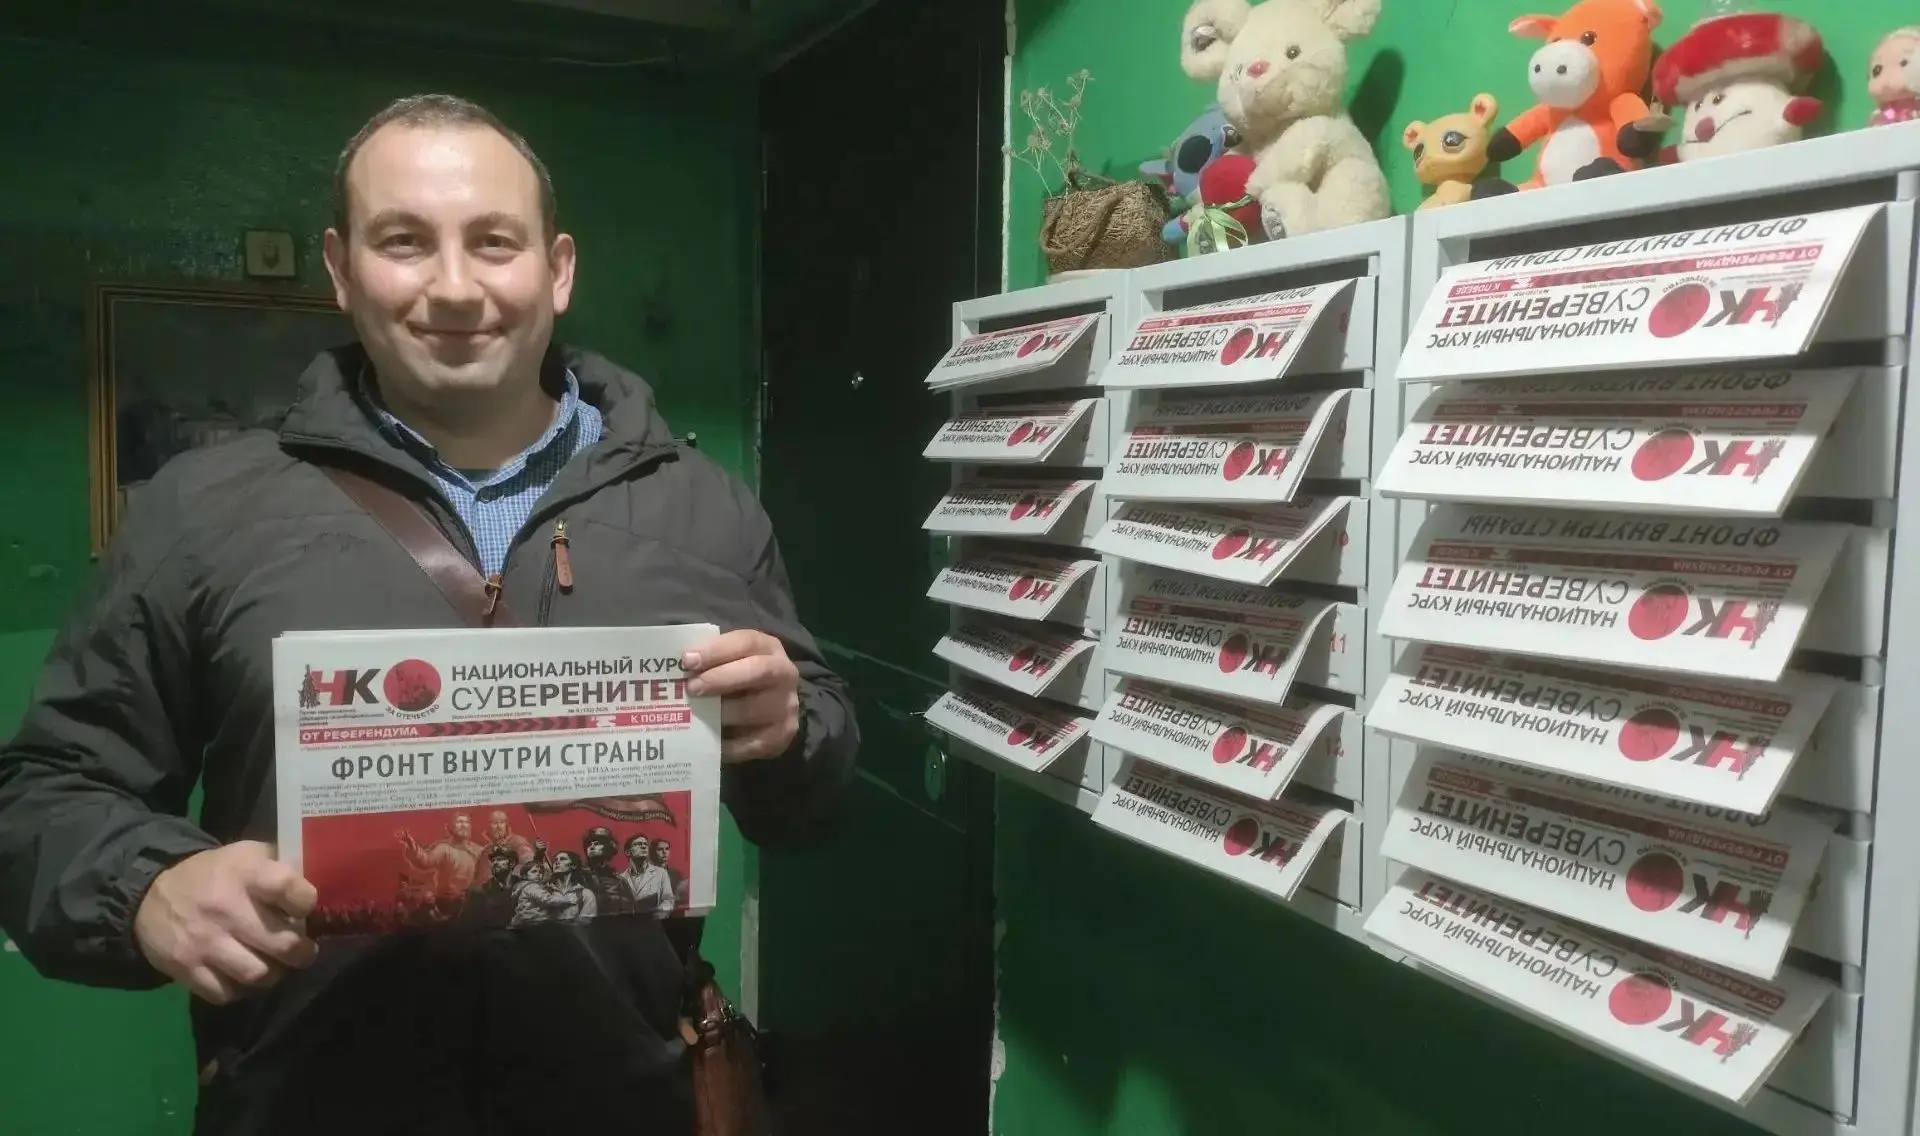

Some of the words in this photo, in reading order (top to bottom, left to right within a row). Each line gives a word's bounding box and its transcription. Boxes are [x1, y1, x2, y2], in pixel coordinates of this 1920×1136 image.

[1694, 217, 1808, 247] ФРОНТ
[1581, 230, 1689, 260] ВНУТРИ
[1796, 246, 1823, 260] ОТ
[1486, 245, 1580, 271] СТРАНЫ
[1456, 284, 1491, 295] ПОБЕДЕ
[1436, 287, 1651, 329] СУВЕРЕНИТЕТ
[1127, 329, 1229, 351] СУВЕРЕНИТЕТ
[1426, 333, 1468, 349] КУРС
[1473, 317, 1638, 347] НАЦИОНАЛЬНЫЙ
[1118, 353, 1140, 365] КУРС
[1140, 350, 1217, 367] НАЦИОНАЛЬНЫЙ
[947, 420, 1019, 432] СУВЕРЕНИТЕТ
[1420, 424, 1636, 449] СУВЕРЕНИТЕТ
[1124, 440, 1228, 459] СУВЕРЕНИТЕТ
[1410, 449, 1452, 465] КУРС
[1455, 450, 1620, 471] НАЦИОНАЛЬНЫЙ
[1117, 462, 1139, 474] КУРС
[1140, 462, 1219, 476] НАЦИОНАЛЬНЫЙ
[1112, 522, 1134, 537] КУРС
[1126, 508, 1225, 537] СУВЕРЕНИТЕТ
[1462, 515, 1560, 536] СТРАНЫ
[1564, 520, 1664, 542] ВНУТРИ
[1133, 525, 1211, 552] НАЦИОНАЛЬНЫЙ
[1671, 525, 1780, 547] ФРОНТ
[1416, 567, 1631, 604] СУВЕРЕНИТЕТ
[1408, 593, 1451, 610] КУРС
[1455, 597, 1618, 628] НАЦИОНАЛЬНЫЙ
[1116, 636, 1138, 650] КУРС
[1122, 617, 1223, 646] СУВЕРЕНИТЕТ
[1138, 640, 1215, 664] НАЦИОНАЛЬНЫЙ
[451, 656, 633, 682] НАЦИОНАЛЬНЫЙ
[451, 678, 688, 711] СУВЕРЕНИТЕТ
[1399, 688, 1442, 709] КУРС
[1409, 664, 1622, 721] СУВЕРЕНИТЕТ
[385, 706, 395, 715] ЗА
[397, 703, 441, 720] ОТЕЧЕСТВО
[631, 715, 638, 723] К
[641, 712, 684, 723] ПОБЕДЕ
[1109, 710, 1131, 725] КУРС
[1117, 693, 1222, 735] СУВЕРЕНИТЕТ
[1445, 698, 1608, 745] НАЦИОНАЛЬНЫЙ
[302, 732, 320, 741] ОТ
[324, 727, 418, 740] РЕФЕРЕНДУМА
[1130, 714, 1210, 752] НАЦИОНАЛЬНЫЙ
[331, 752, 434, 780] ФРОНТ
[443, 746, 551, 774] ВНУТРИ
[560, 738, 665, 766] СТРАНЫ
[1112, 793, 1136, 811] КУРС
[1121, 776, 1232, 826] СУВЕРЕНИТЕТ
[1135, 804, 1220, 842] НАЦИОНАЛЬНЫЙ
[1410, 817, 1452, 842] КУРС
[1418, 792, 1627, 866] СУВЕРЕНИТЕТ
[1456, 828, 1616, 890] НАЦИОНАЛЬНЫЙ
[1400, 901, 1441, 930] КУРС
[1414, 881, 1619, 978] СУВЕРЕНИТЕТ
[1443, 922, 1601, 999] НАЦИОНАЛЬНЫЙ
